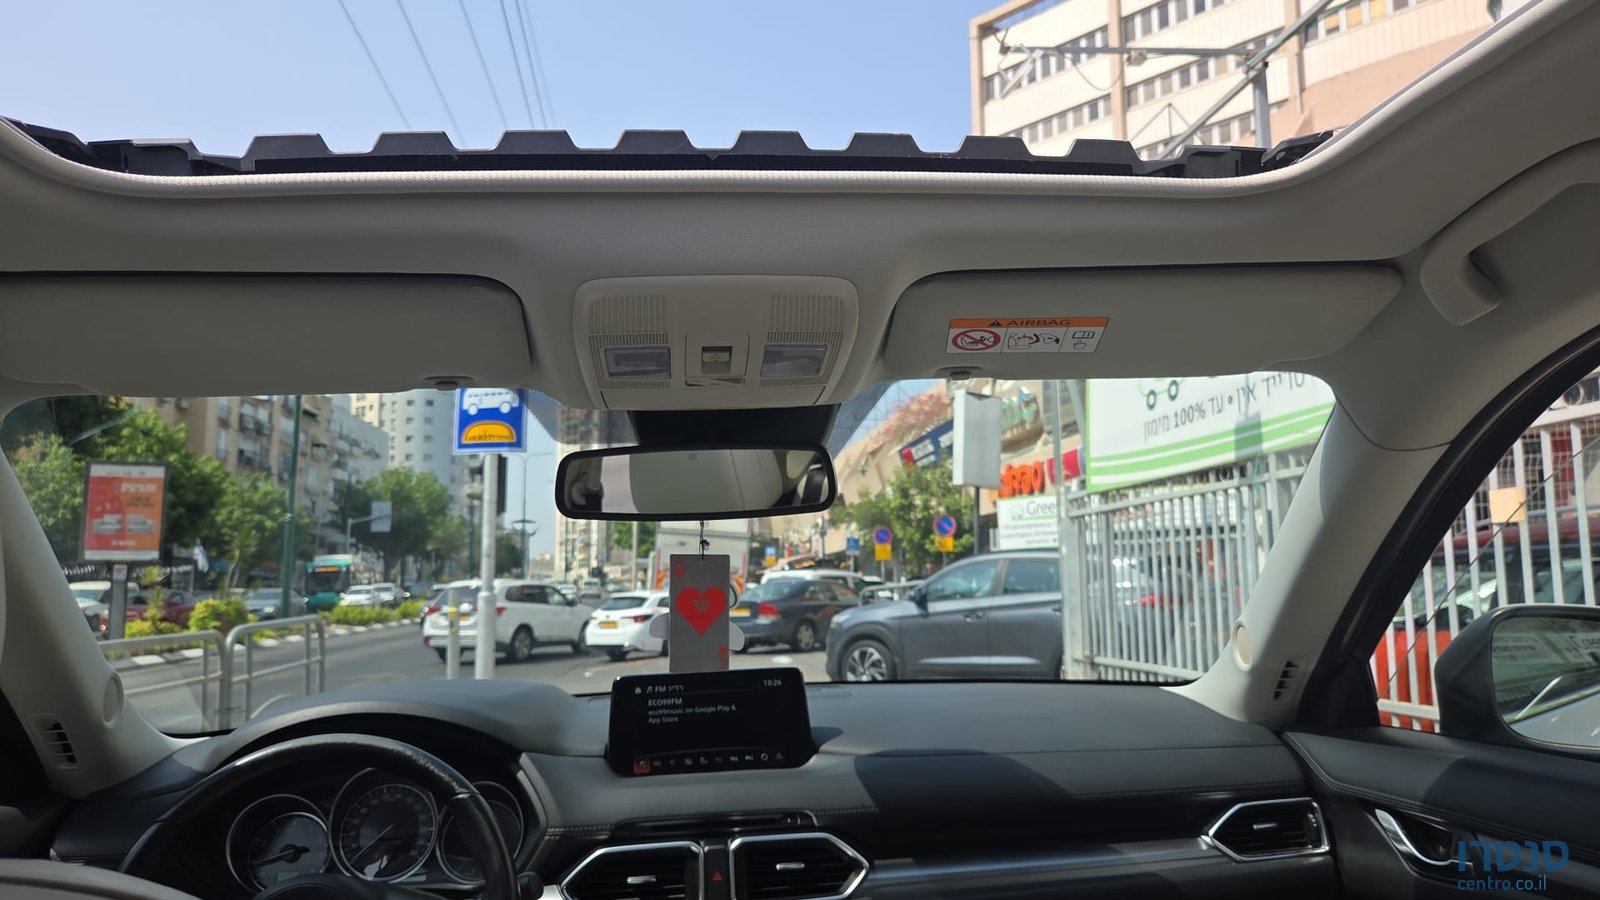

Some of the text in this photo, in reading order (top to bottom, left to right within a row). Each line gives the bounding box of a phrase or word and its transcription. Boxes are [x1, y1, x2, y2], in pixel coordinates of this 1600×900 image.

[1007, 319, 1072, 327] AIRBAG
[1207, 394, 1224, 415] עד
[1174, 400, 1206, 428] 100%
[1143, 415, 1170, 446] מימון
[1026, 500, 1057, 516] Gree
[655, 685, 667, 693] FM
[764, 679, 782, 687] 10:26
[648, 697, 682, 706] ECO99FM
[648, 708, 684, 716] eco99music
[694, 706, 717, 714] Google
[717, 704, 731, 713] Play
